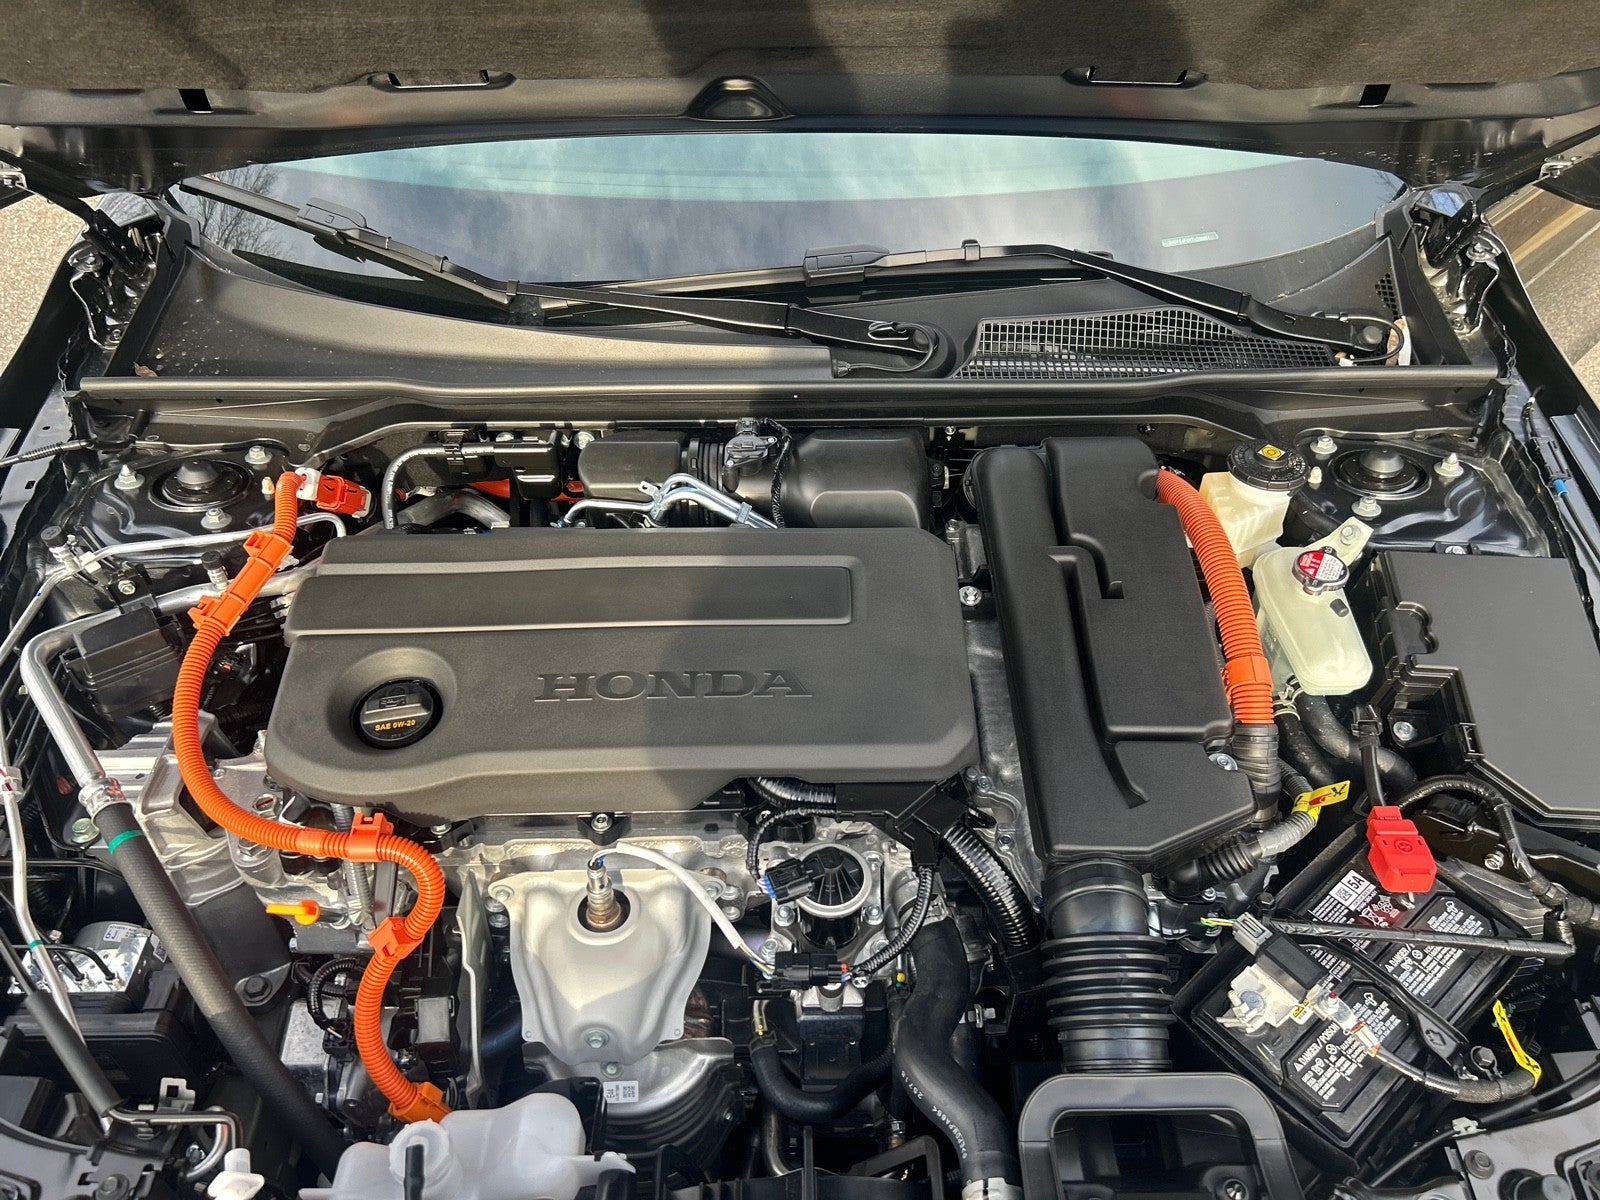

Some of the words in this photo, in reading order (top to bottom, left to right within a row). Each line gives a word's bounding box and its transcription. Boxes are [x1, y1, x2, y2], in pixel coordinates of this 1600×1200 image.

[535, 670, 812, 702] HONDA
[374, 722, 391, 731] SAE
[393, 719, 416, 729] 0W-20
[1347, 875, 1365, 890] 5A
